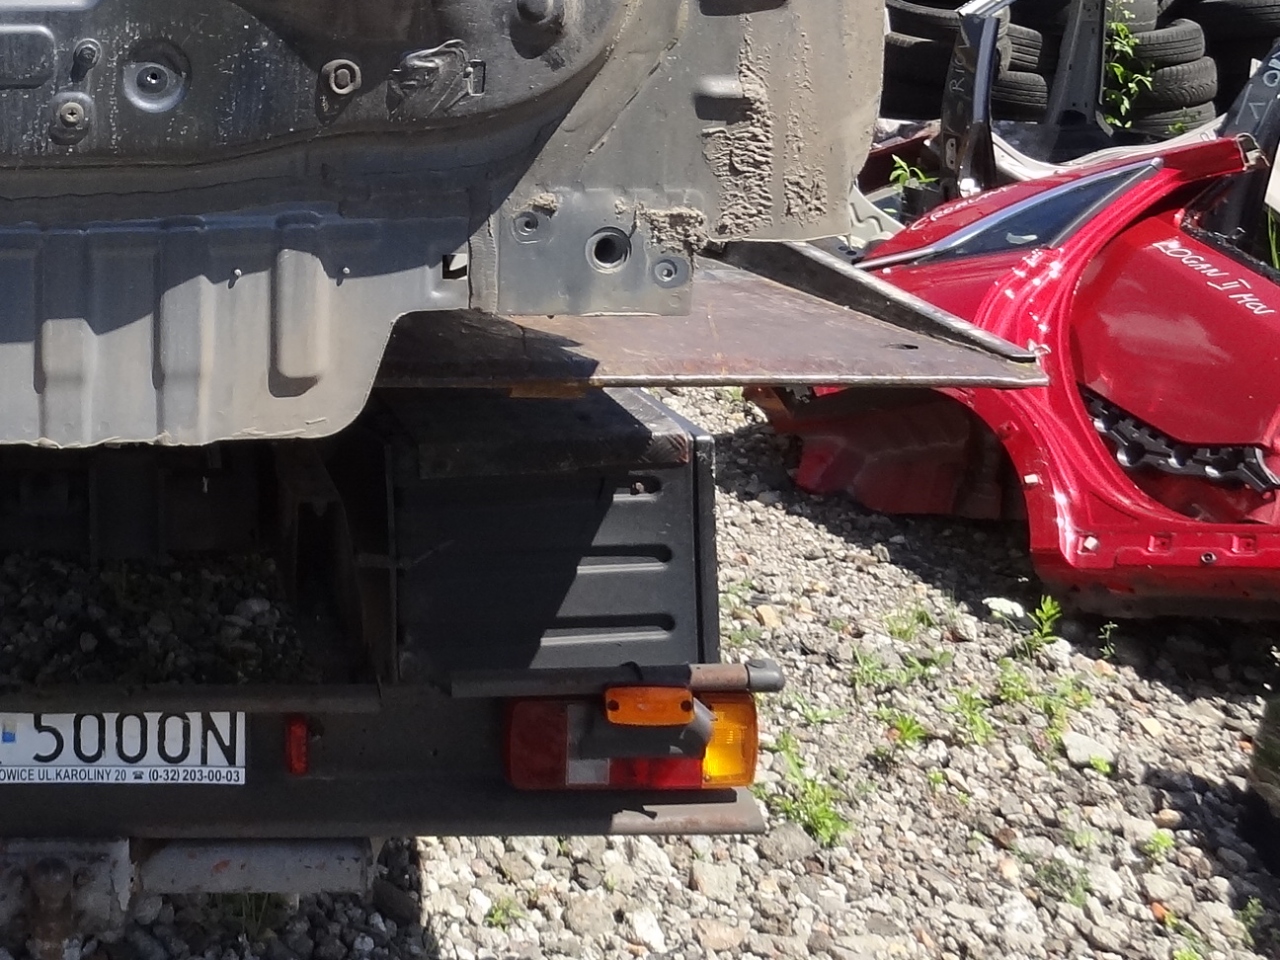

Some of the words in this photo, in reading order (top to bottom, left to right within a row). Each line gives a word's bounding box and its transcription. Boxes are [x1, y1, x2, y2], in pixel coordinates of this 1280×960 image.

[32, 711, 237, 765] 5000N
[114, 769, 127, 782] 20
[148, 768, 180, 783] (0-32)
[182, 769, 240, 782] 203-00-03
